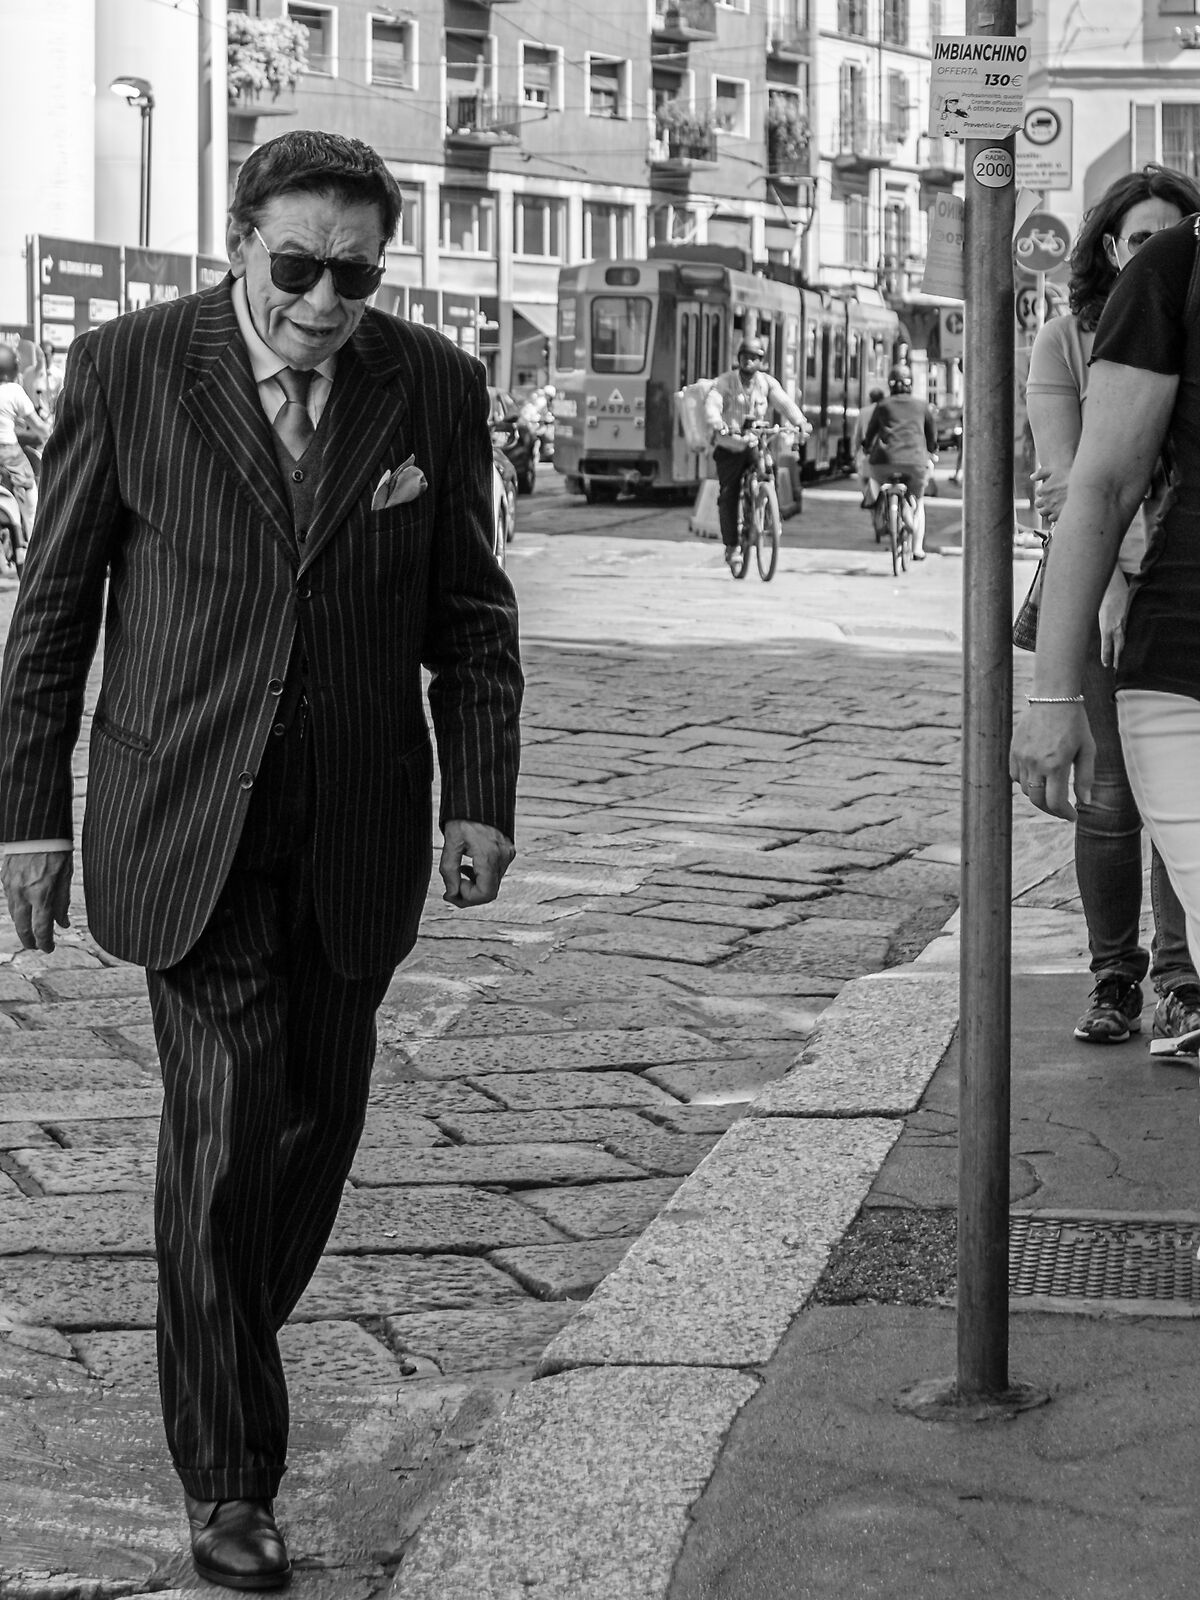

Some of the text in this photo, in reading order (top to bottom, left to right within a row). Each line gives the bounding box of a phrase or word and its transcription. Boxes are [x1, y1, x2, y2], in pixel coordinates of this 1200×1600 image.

[934, 43, 1027, 62] IMBIANCHINO
[937, 66, 978, 76] OFFERTA
[984, 74, 1023, 87] 130€
[985, 154, 1006, 162] RADIO
[976, 162, 1013, 177] 2000
